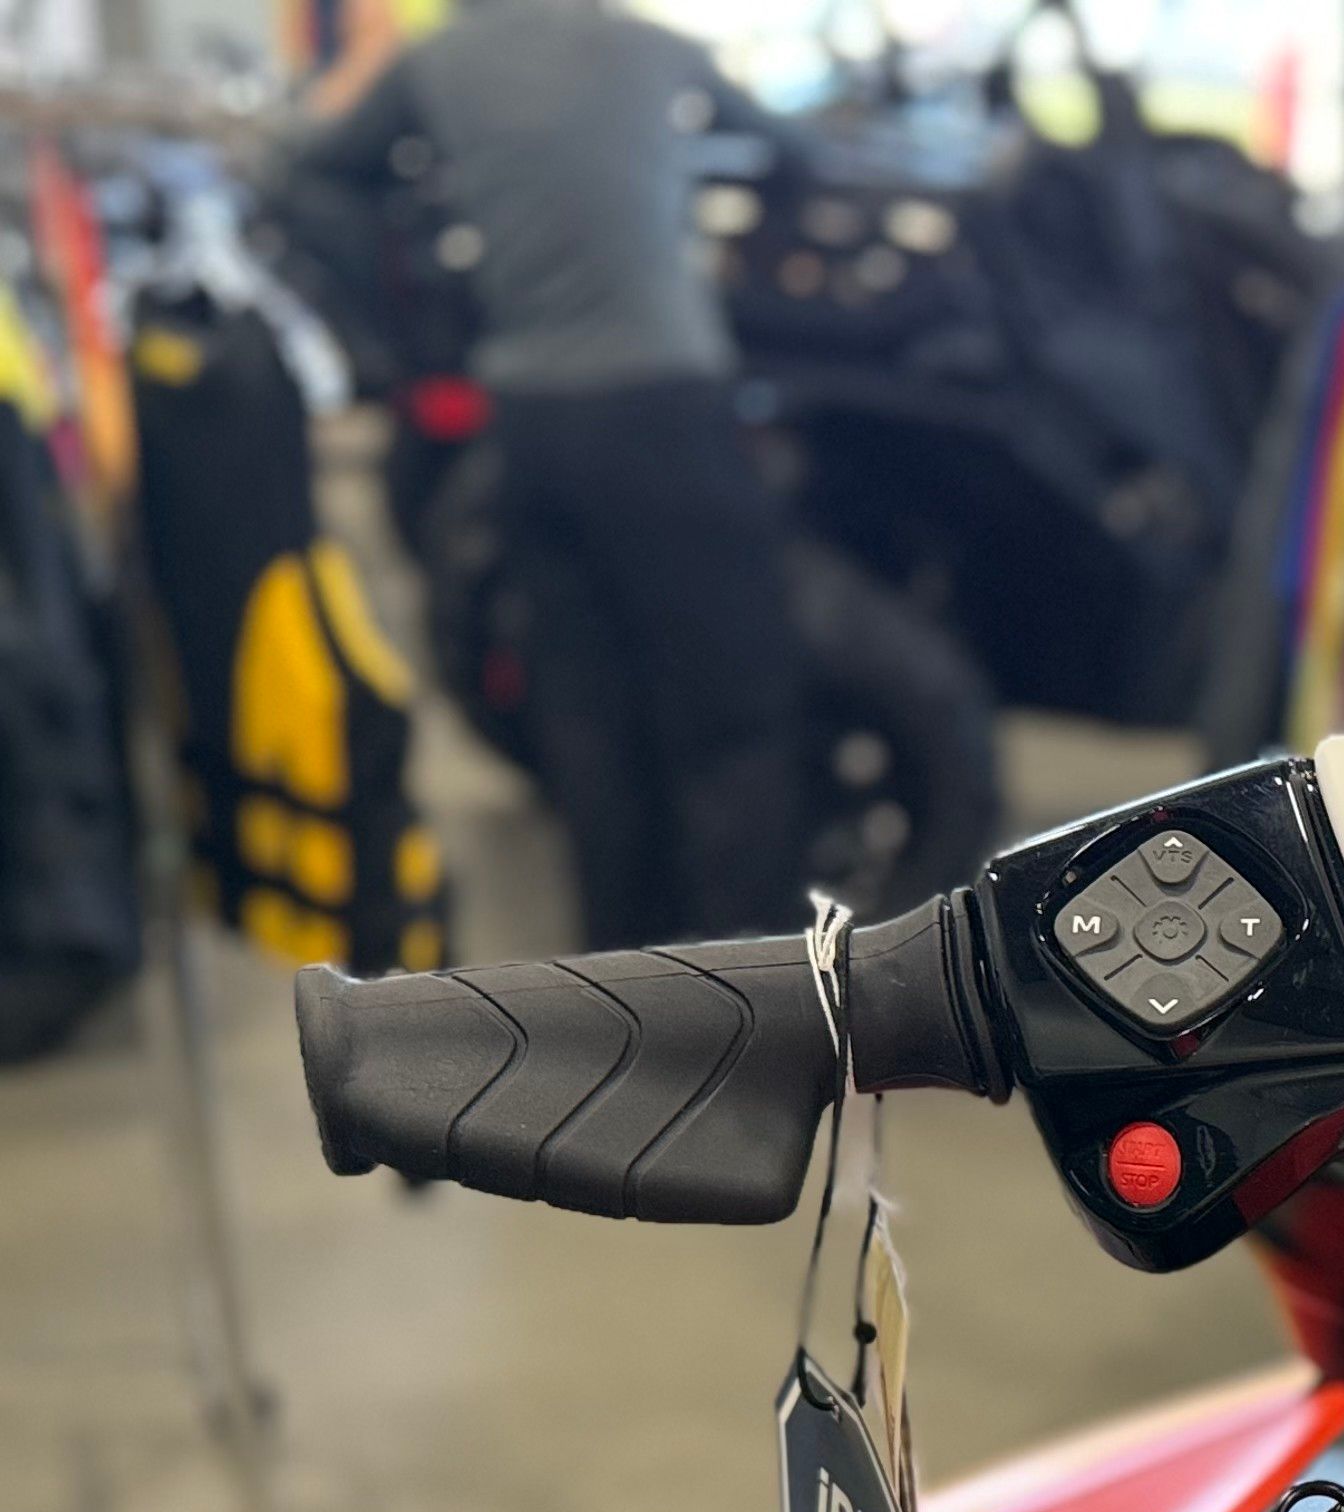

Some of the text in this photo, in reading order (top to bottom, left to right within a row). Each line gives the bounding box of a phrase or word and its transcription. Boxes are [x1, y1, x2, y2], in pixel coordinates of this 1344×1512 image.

[1153, 850, 1193, 864] VTS
[1072, 915, 1101, 934] M
[1241, 918, 1260, 936] T
[1120, 1172, 1159, 1188] STOP
